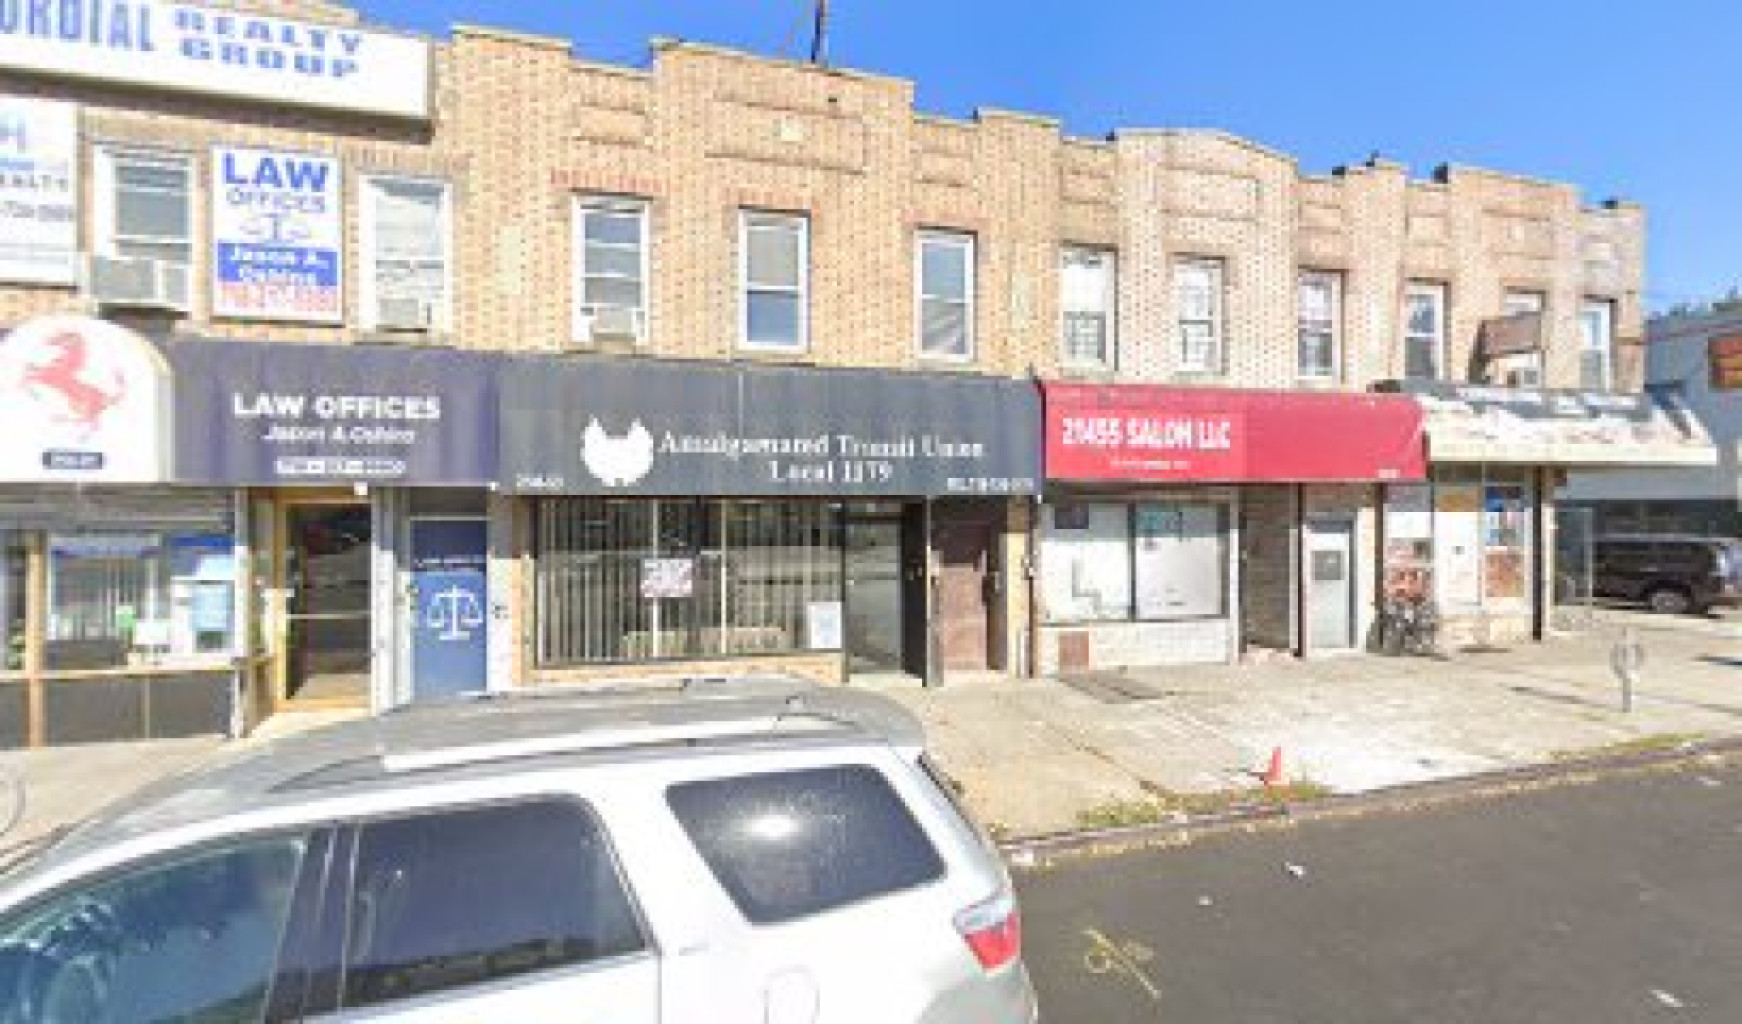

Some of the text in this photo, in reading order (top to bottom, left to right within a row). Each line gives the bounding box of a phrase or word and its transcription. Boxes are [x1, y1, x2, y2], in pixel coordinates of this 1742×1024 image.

[174, 8, 363, 54] REALTY
[180, 37, 360, 78] GROUP
[223, 153, 329, 193] LAW
[226, 187, 326, 214] OFFICES
[233, 392, 441, 420] LAW OFFICES
[658, 430, 986, 461] Amalgamated Transit Union
[1127, 417, 1193, 449] SALON
[769, 460, 834, 483] Local
